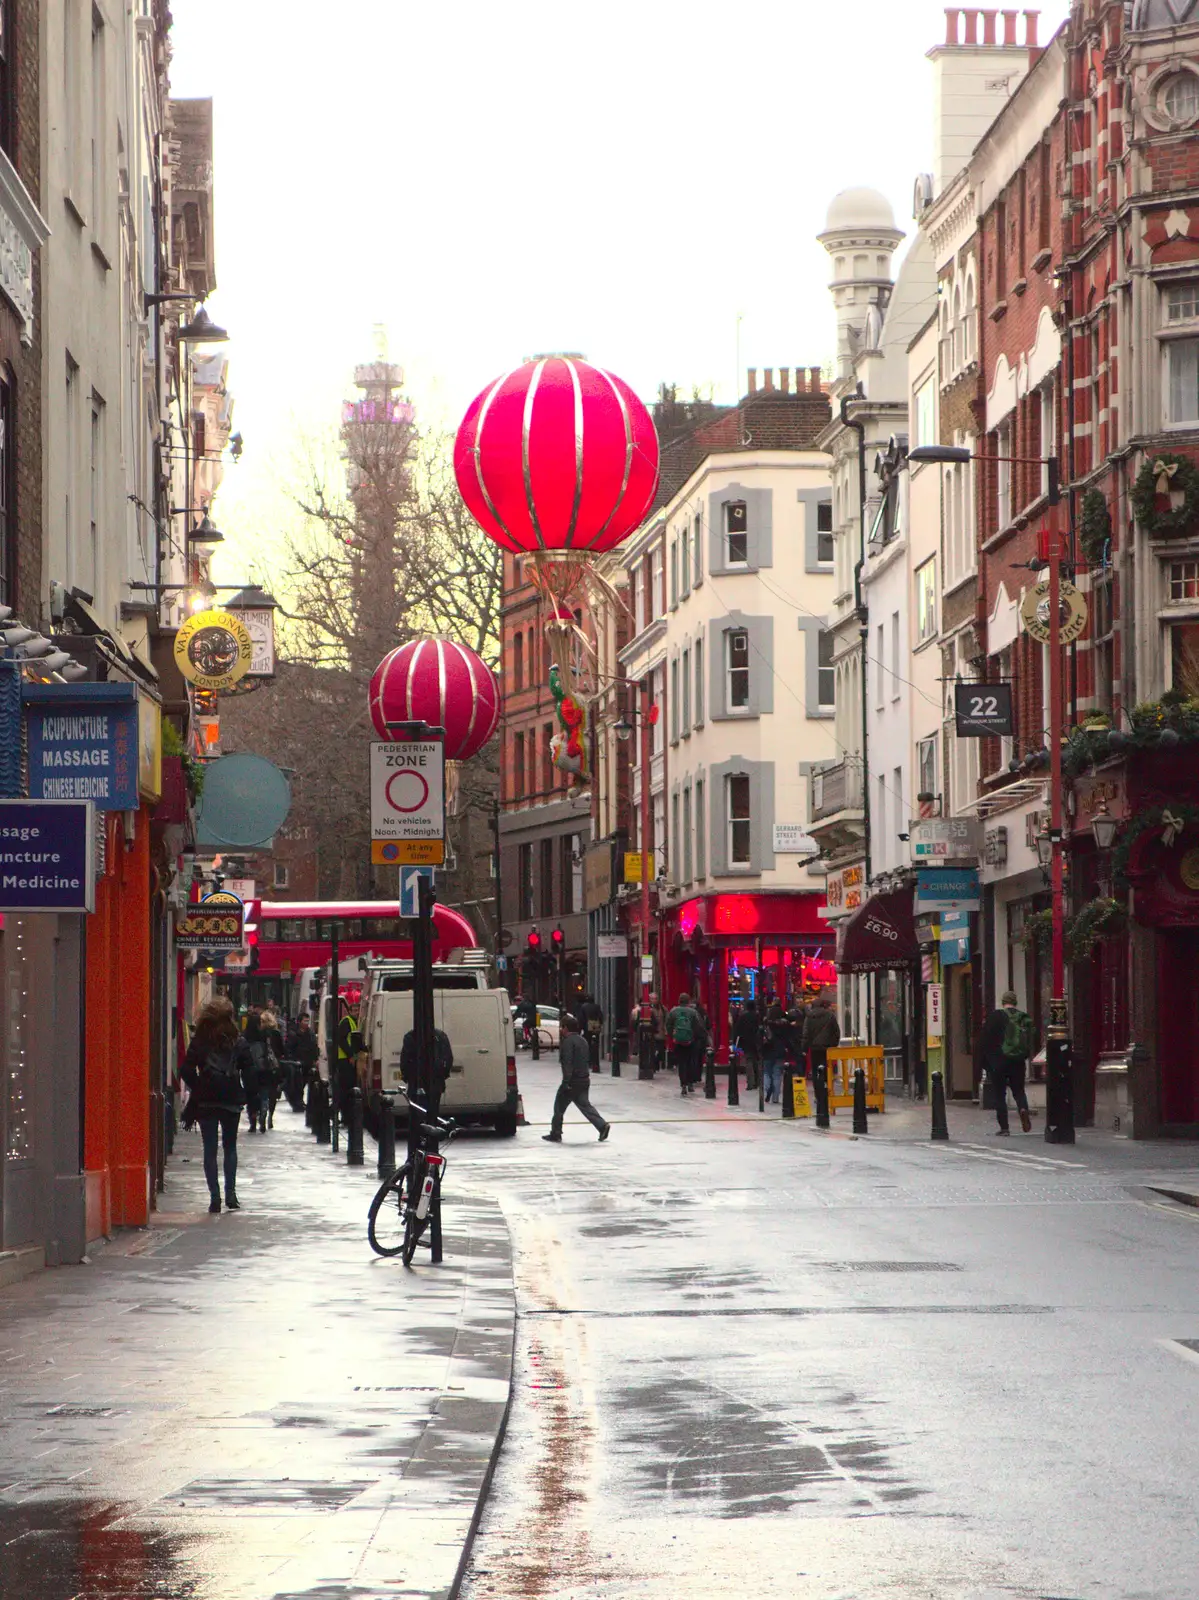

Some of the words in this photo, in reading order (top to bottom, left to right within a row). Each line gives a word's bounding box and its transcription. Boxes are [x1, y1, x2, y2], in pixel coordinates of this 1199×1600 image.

[193, 674, 234, 687] LONDON
[970, 696, 998, 716] 22
[42, 716, 108, 740] ACUPUNCTURE
[377, 745, 435, 753] PEDESTRIAN
[42, 750, 109, 766] MASSAGE
[386, 755, 427, 766] ZONE
[42, 777, 74, 799] CHINESE
[75, 777, 109, 798] MEDICINE
[398, 817, 432, 825] vehicles
[374, 828, 397, 836] Noon
[403, 828, 440, 837] Midnight
[419, 844, 433, 852] any
[3, 875, 80, 888] Medicine
